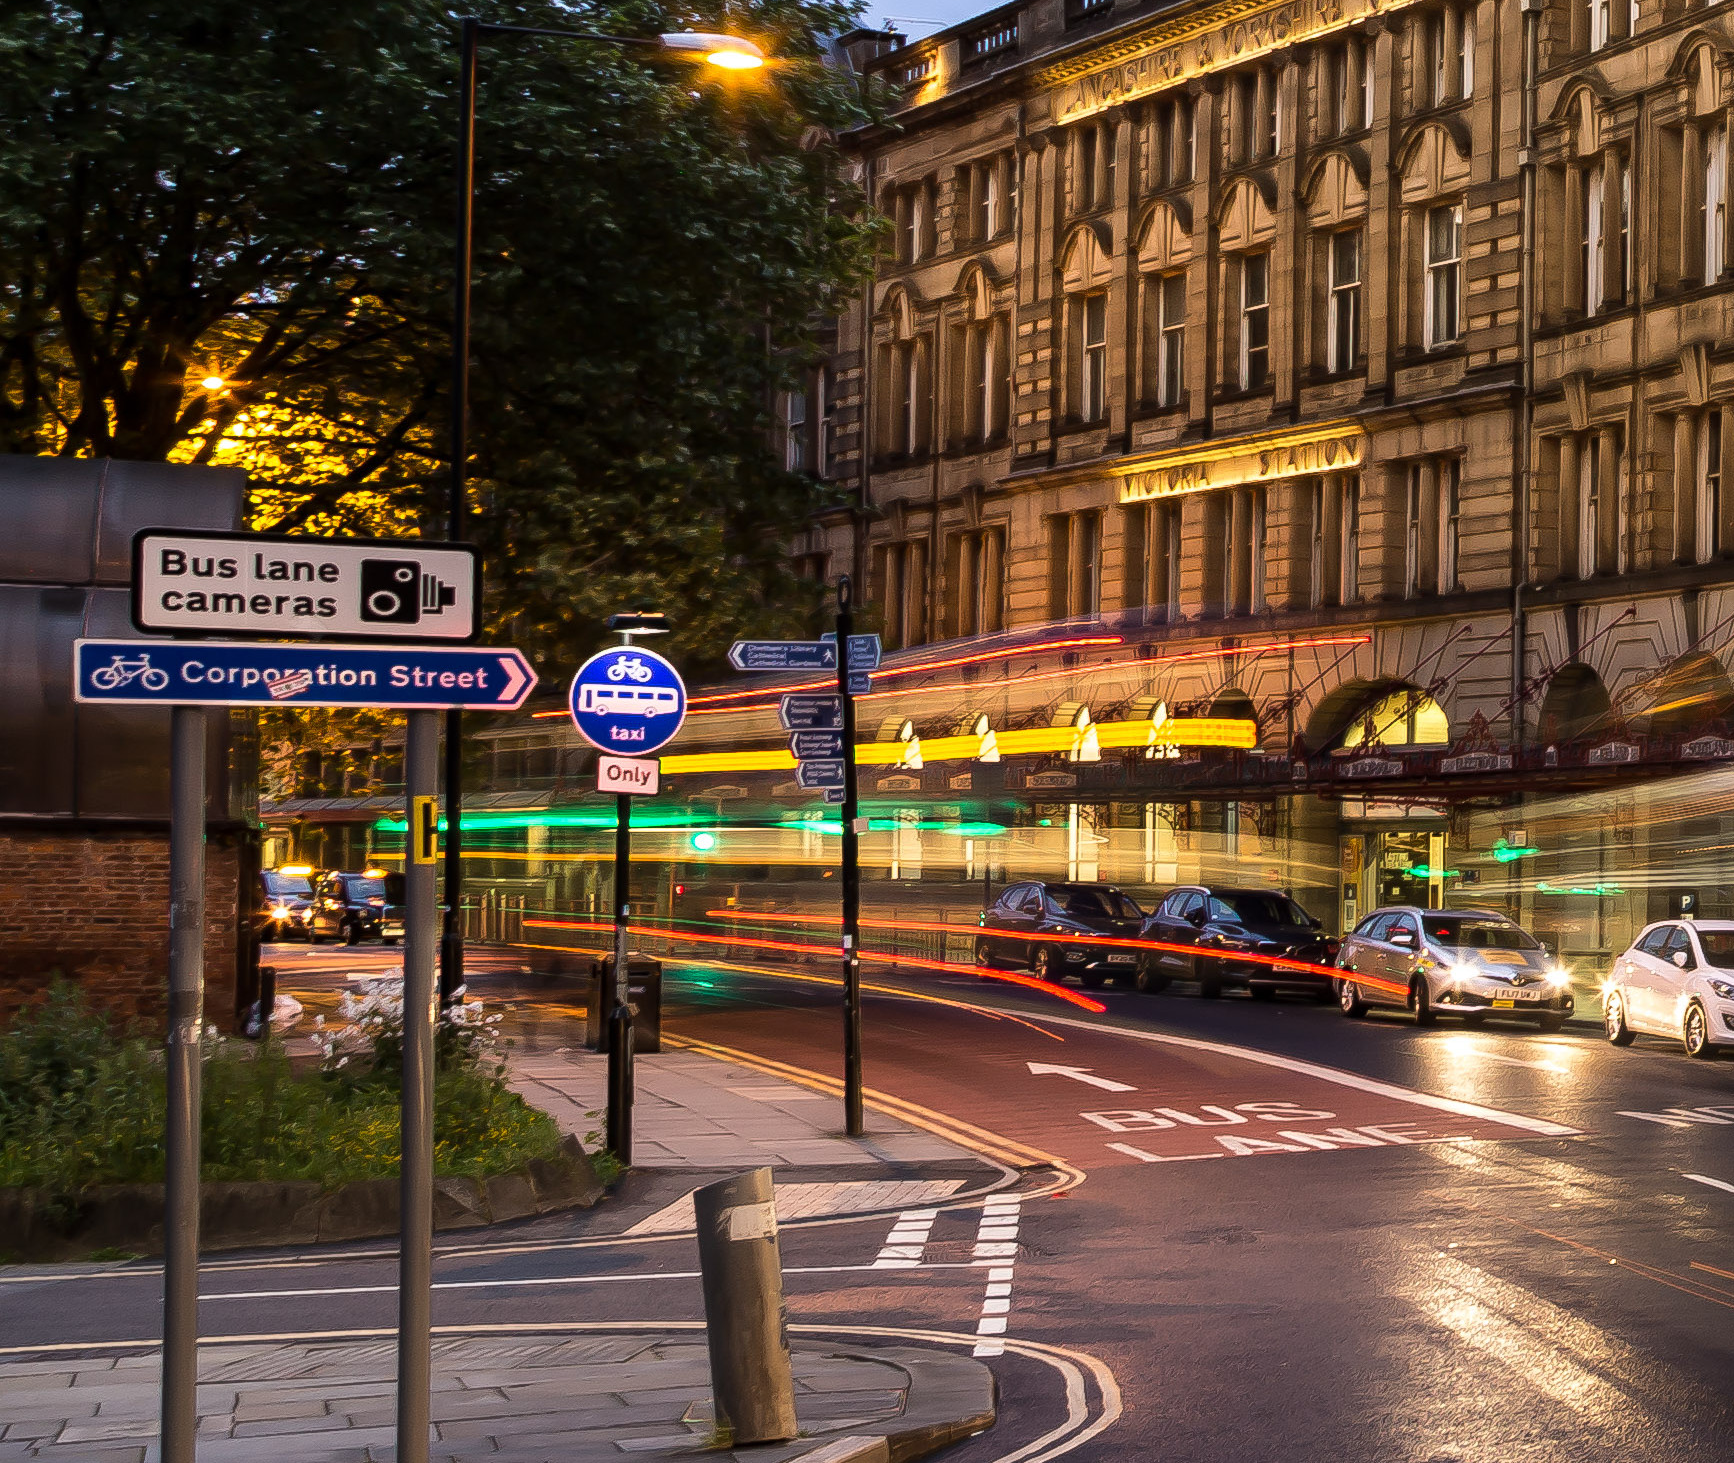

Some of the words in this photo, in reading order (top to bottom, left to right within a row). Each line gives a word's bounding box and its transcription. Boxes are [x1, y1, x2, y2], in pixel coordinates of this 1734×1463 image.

[1064, 49, 1184, 115] LANCASHIRE
[1198, 38, 1213, 64] &
[1122, 461, 1212, 497] VICTORIA
[1258, 437, 1360, 477] STATION
[160, 548, 239, 579] Bus
[254, 552, 340, 584] lane
[160, 589, 338, 618] cameras
[180, 660, 377, 689] Corporation
[390, 664, 489, 689] Street
[609, 724, 646, 741] taxi
[606, 764, 652, 786] Only
[1681, 895, 1691, 909] P
[1078, 1101, 1337, 1133] BUS
[1104, 1122, 1474, 1163] LANE
